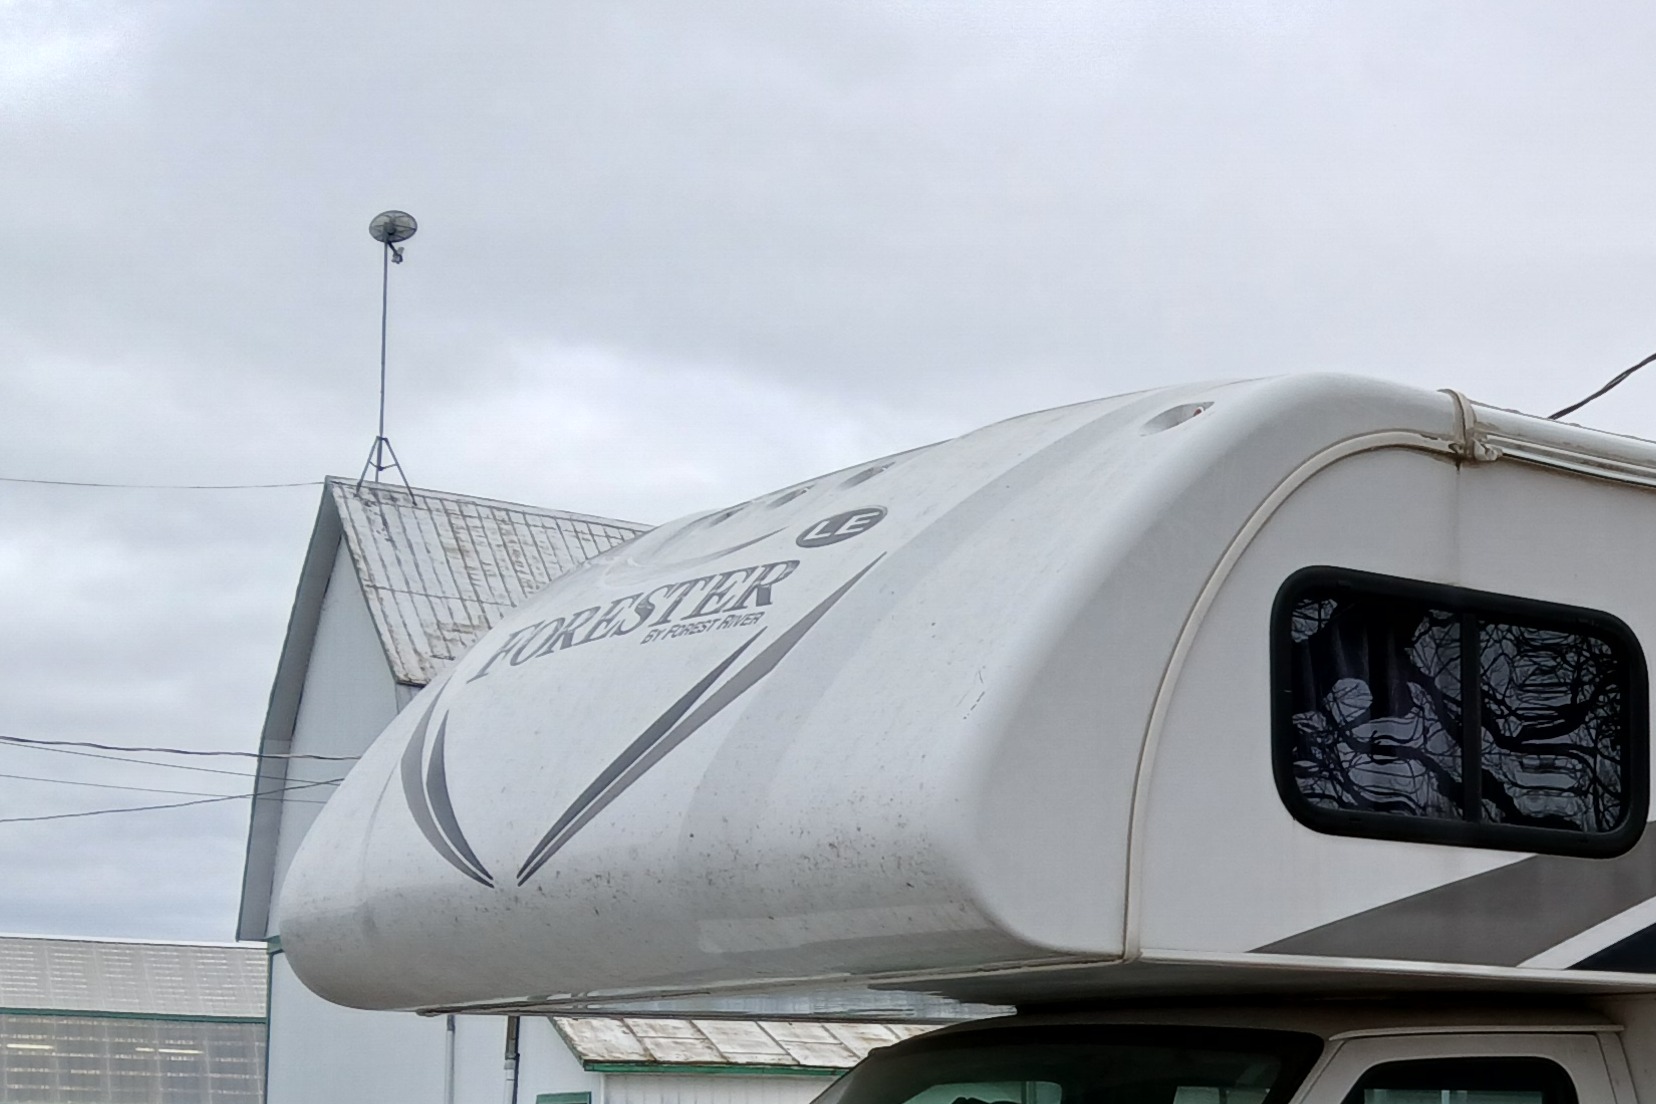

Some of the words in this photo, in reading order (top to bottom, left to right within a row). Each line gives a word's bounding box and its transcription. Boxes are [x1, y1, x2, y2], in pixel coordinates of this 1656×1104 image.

[802, 511, 881, 541] LE
[467, 559, 801, 684] FORESTER
[640, 627, 666, 645] BY
[661, 618, 721, 640] FOREST
[716, 611, 765, 631] RIVER
